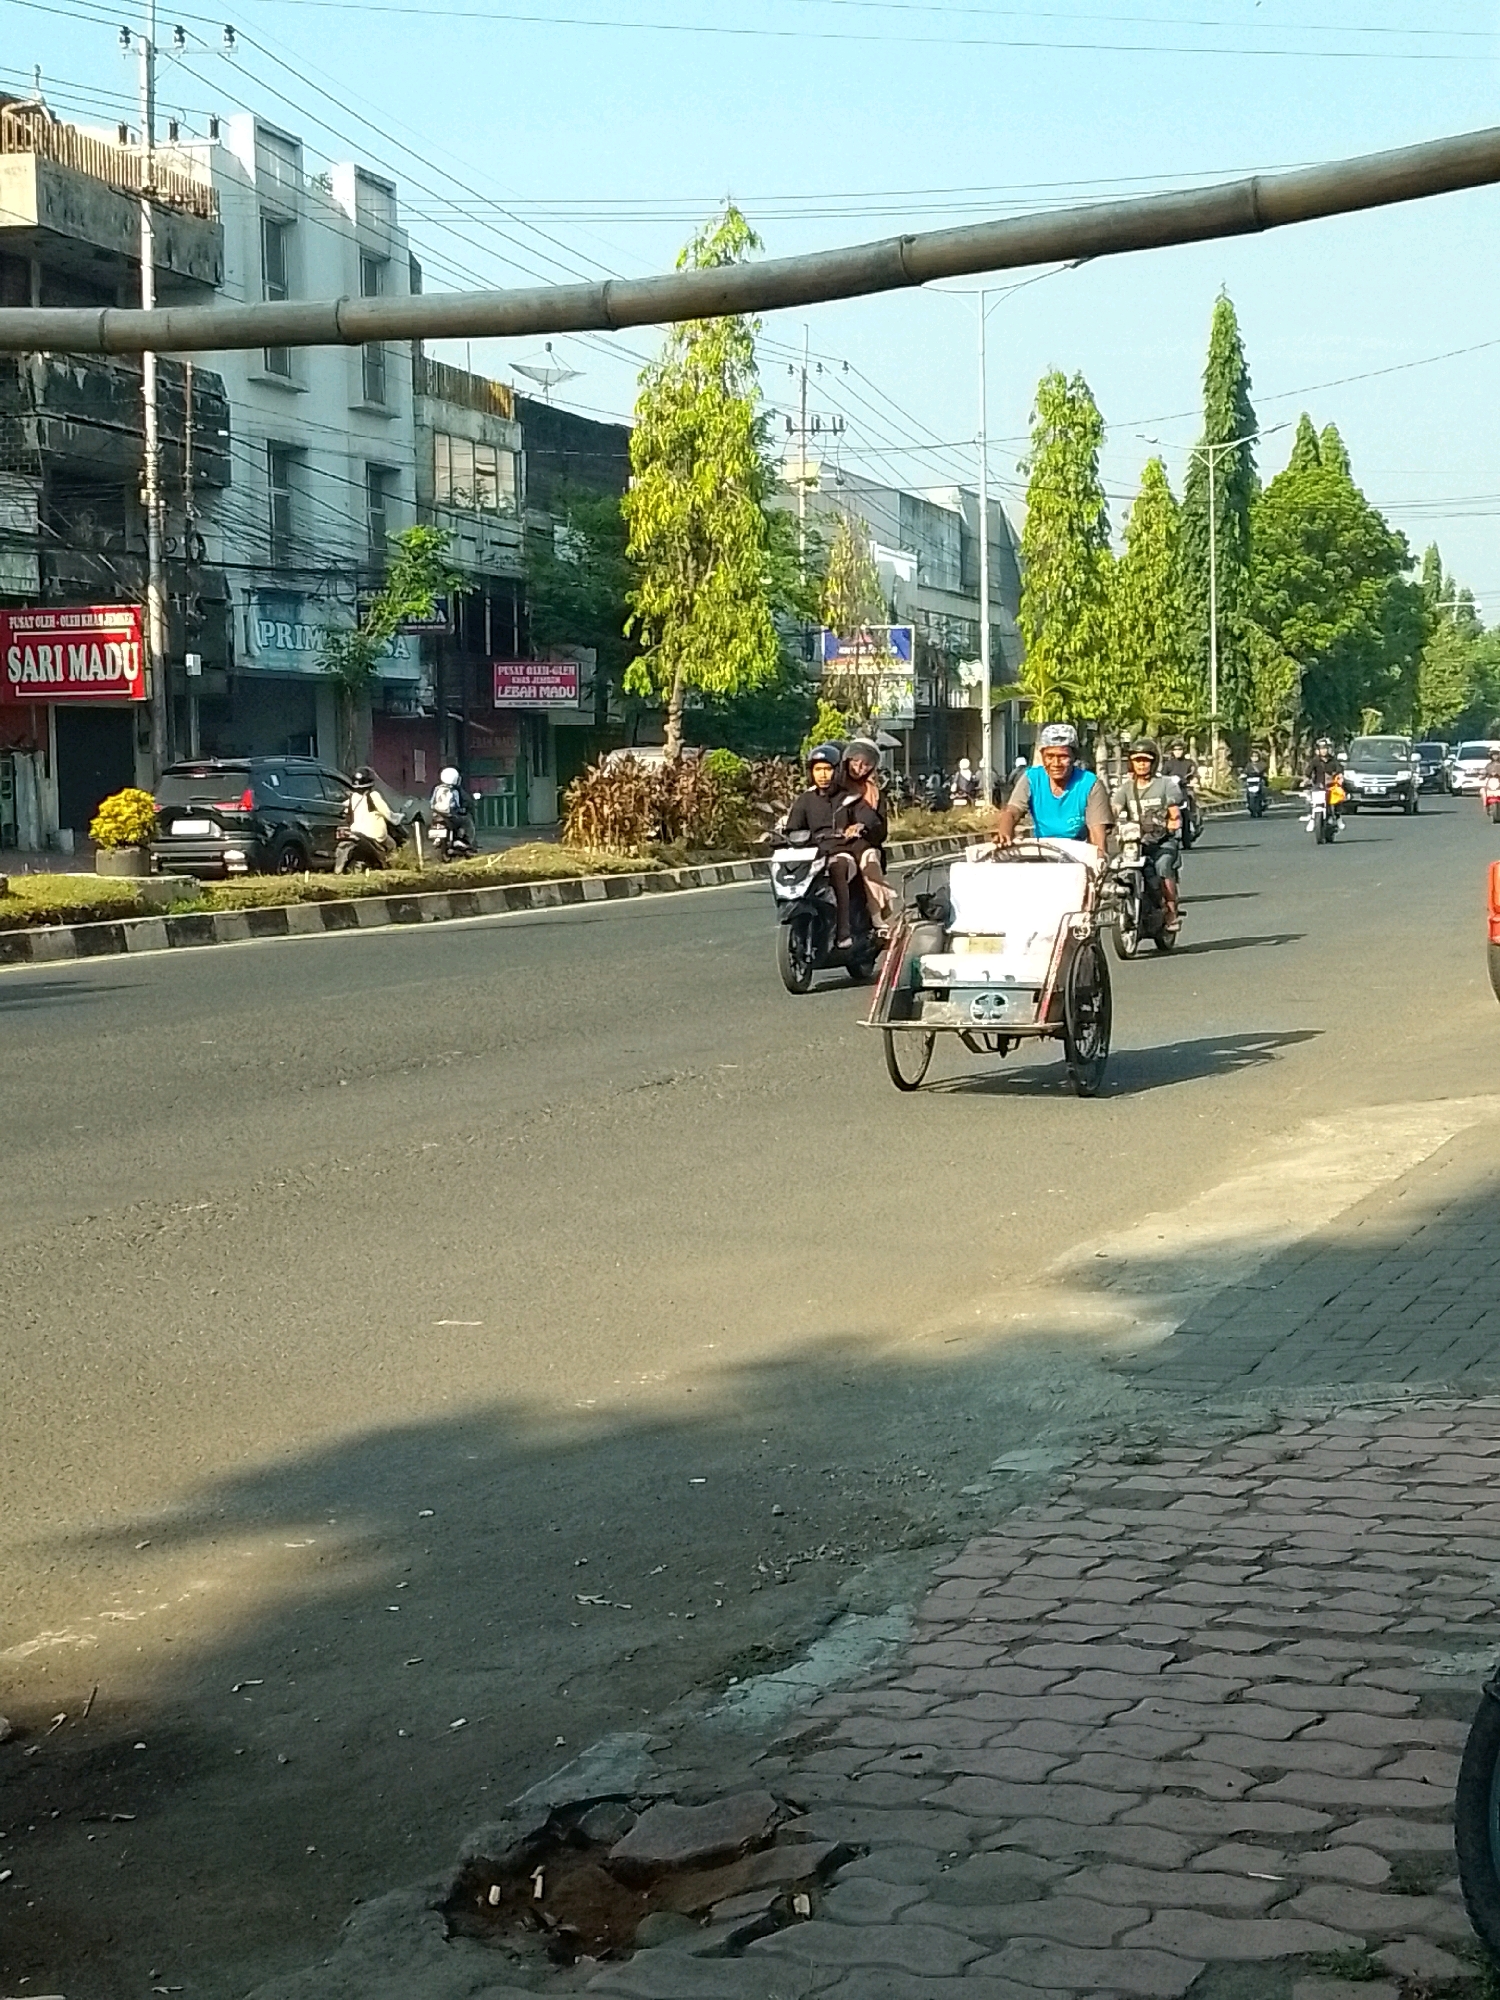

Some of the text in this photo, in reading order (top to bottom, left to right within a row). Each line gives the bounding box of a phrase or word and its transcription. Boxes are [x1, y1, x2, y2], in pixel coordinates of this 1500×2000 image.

[8, 615, 35, 629] PUSAT
[81, 613, 104, 626] KHAS
[257, 618, 329, 649] PRIM
[7, 641, 139, 683] SARI MADU
[498, 685, 576, 698] LEBAH MADU
